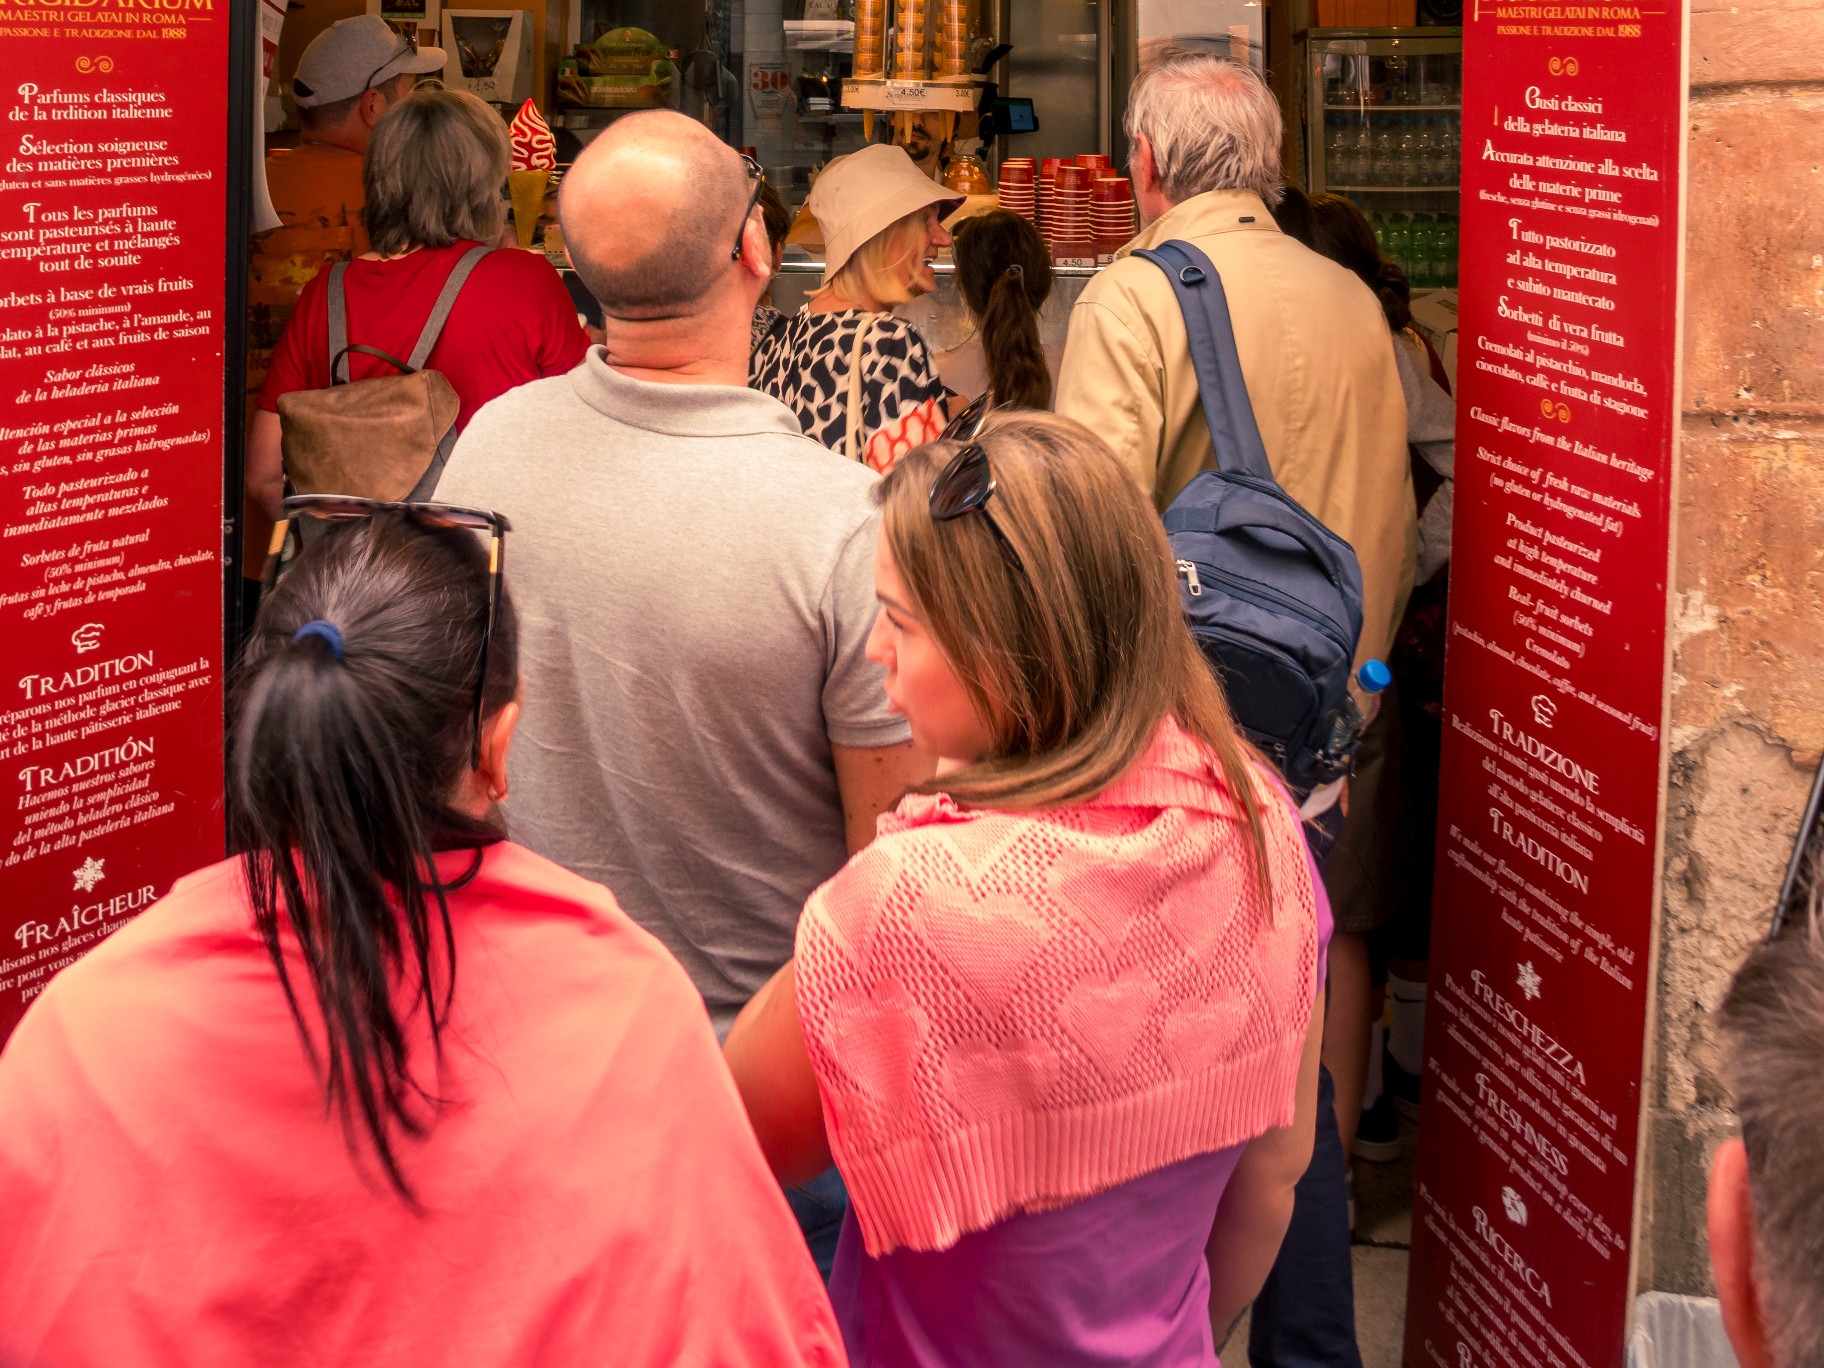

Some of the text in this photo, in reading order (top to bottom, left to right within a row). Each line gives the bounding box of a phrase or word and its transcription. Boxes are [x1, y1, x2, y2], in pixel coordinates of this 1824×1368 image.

[0, 9, 186, 25] MAESTRI GELATAI IN ROMA
[1496, 6, 1641, 19] MAESTRI GELATAI IN ROMA
[0, 27, 187, 39] PASSIONE E TRADIZIONE DAL 1988
[1496, 25, 1532, 35] PASSIONE
[1533, 25, 1539, 36] E
[1540, 25, 1595, 37] TRADIZIONE
[1596, 26, 1617, 37] DAL
[17, 82, 166, 106] Parfums classiques
[752, 70, 788, 91] 30
[901, 88, 925, 97] 4.50€
[8, 103, 173, 121] de la trdition italienne
[1524, 85, 1603, 114] Gusti classici
[1503, 115, 1627, 143] della gelateria italiana
[18, 133, 168, 156] Sélection soigneuse
[5, 152, 179, 173] des matières premières
[1481, 138, 1659, 182] Accurata attenzione alla scelta
[31, 180, 42, 189] et
[44, 179, 68, 188] sans
[68, 175, 113, 187] matières
[113, 175, 149, 186] grasses
[1508, 172, 1623, 204] delle materie prime
[22, 202, 158, 224] Tous les parfums
[0, 217, 177, 243] sont pasteurisés à haute
[95, 239, 110, 252] et
[113, 232, 181, 250] mélangés
[1508, 217, 1617, 258] Tutto pastorizzato
[39, 250, 142, 273] tout de souite
[1062, 258, 1083, 266] 4.50
[1506, 249, 1617, 286] ad alta temperatura
[0, 275, 194, 308] orbets à base de vrais fruits
[1506, 276, 1616, 311] e subito mantecato
[34, 325, 44, 338] à
[47, 323, 59, 337] la
[62, 317, 120, 338] pistache,
[122, 315, 131, 328] à
[133, 308, 194, 327] l'amande,
[196, 309, 212, 320] au
[1497, 295, 1625, 348] Sorbetti di vera frutta
[24, 345, 42, 357] au
[45, 338, 73, 354] café
[75, 338, 89, 350] et
[91, 337, 116, 348] aux
[118, 329, 152, 345] fruits
[153, 327, 170, 341] de
[172, 324, 210, 338] saison
[1477, 335, 1524, 361] Cremolati
[1524, 348, 1535, 364] al
[15, 389, 32, 404] de
[34, 387, 48, 402] la
[112, 374, 160, 391] italiana
[43, 367, 83, 383] Sabor
[1550, 382, 1559, 393] e
[1559, 379, 1589, 402] frutta
[1589, 389, 1602, 406] di
[1602, 396, 1649, 419] stagione
[18, 649, 154, 700] TRADITION
[18, 735, 154, 792] TRADITIÓN
[1489, 708, 1600, 795] TRADIZIONE
[1489, 807, 1589, 895] TRADITION
[14, 884, 159, 949] FRAÎCHEUR
[1470, 969, 1587, 1086] FRESCHEZZA
[1474, 1072, 1569, 1176] FRESHNESS
[1472, 1205, 1552, 1308] RICERCA
